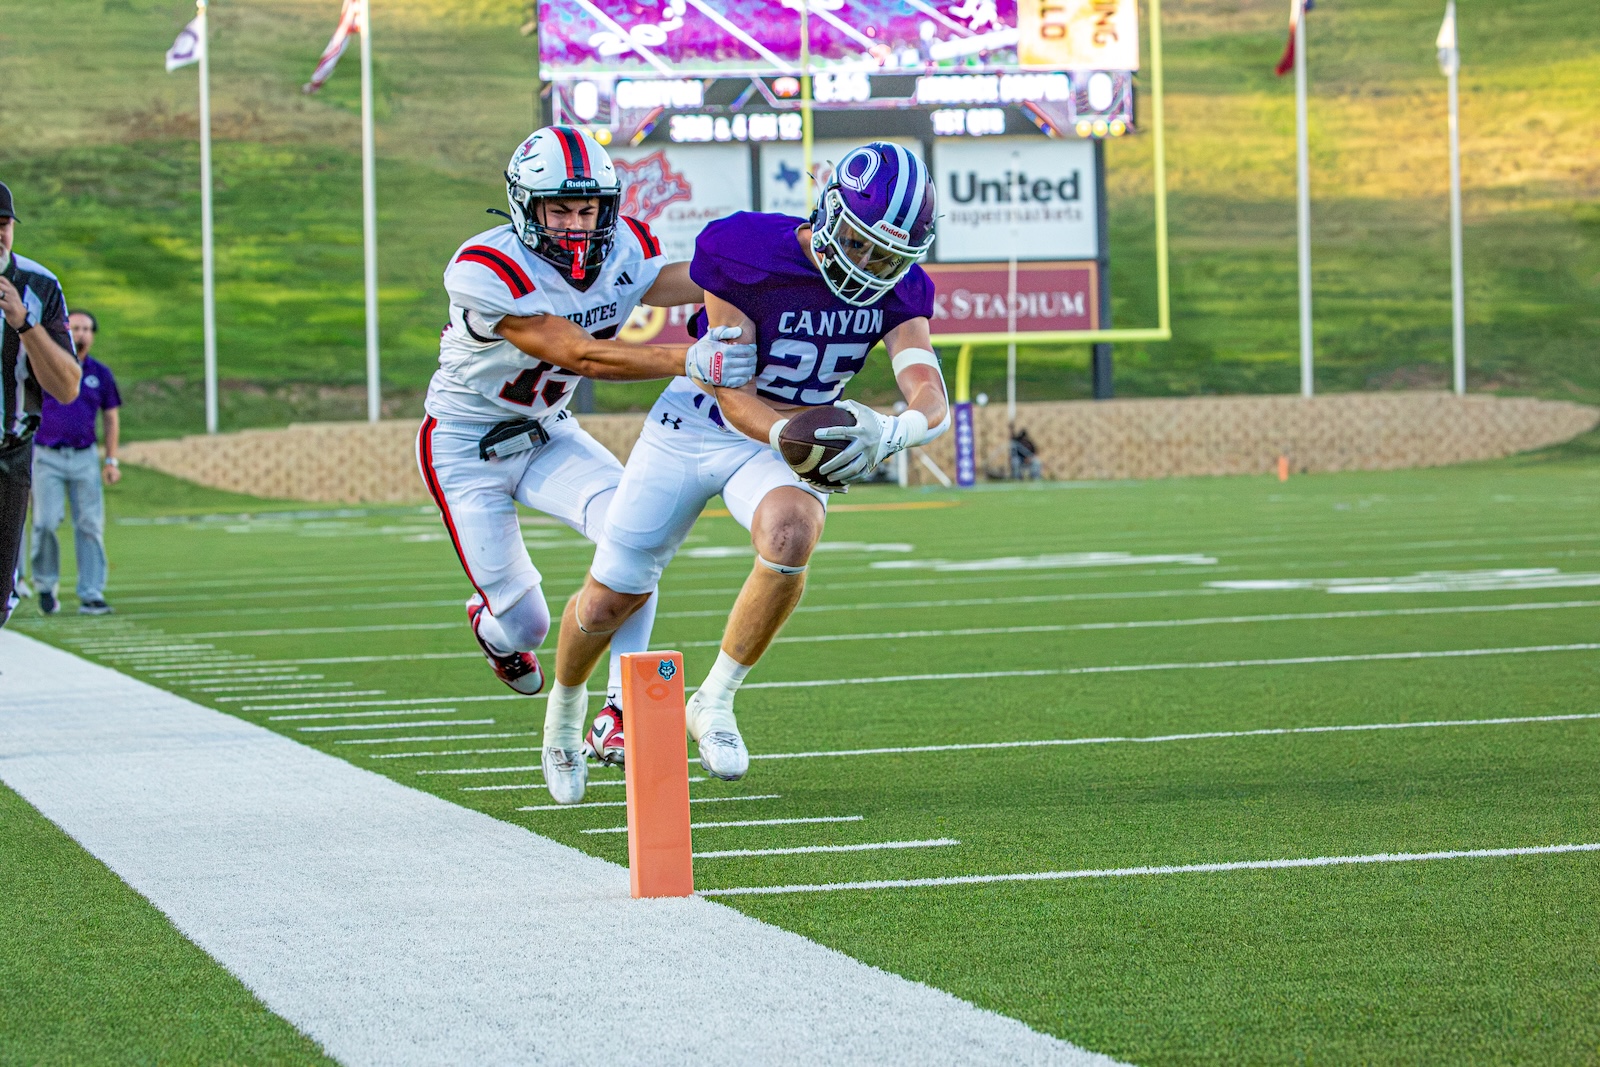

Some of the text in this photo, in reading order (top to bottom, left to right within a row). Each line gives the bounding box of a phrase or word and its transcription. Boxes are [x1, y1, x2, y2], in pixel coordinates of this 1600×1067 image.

[566, 179, 596, 188] Riddell
[950, 169, 1080, 204] United
[880, 223, 908, 241] Riddell
[563, 302, 617, 328] RATES
[951, 288, 1086, 320] STADIUM
[778, 309, 884, 337] CANYON
[756, 338, 870, 404] 25
